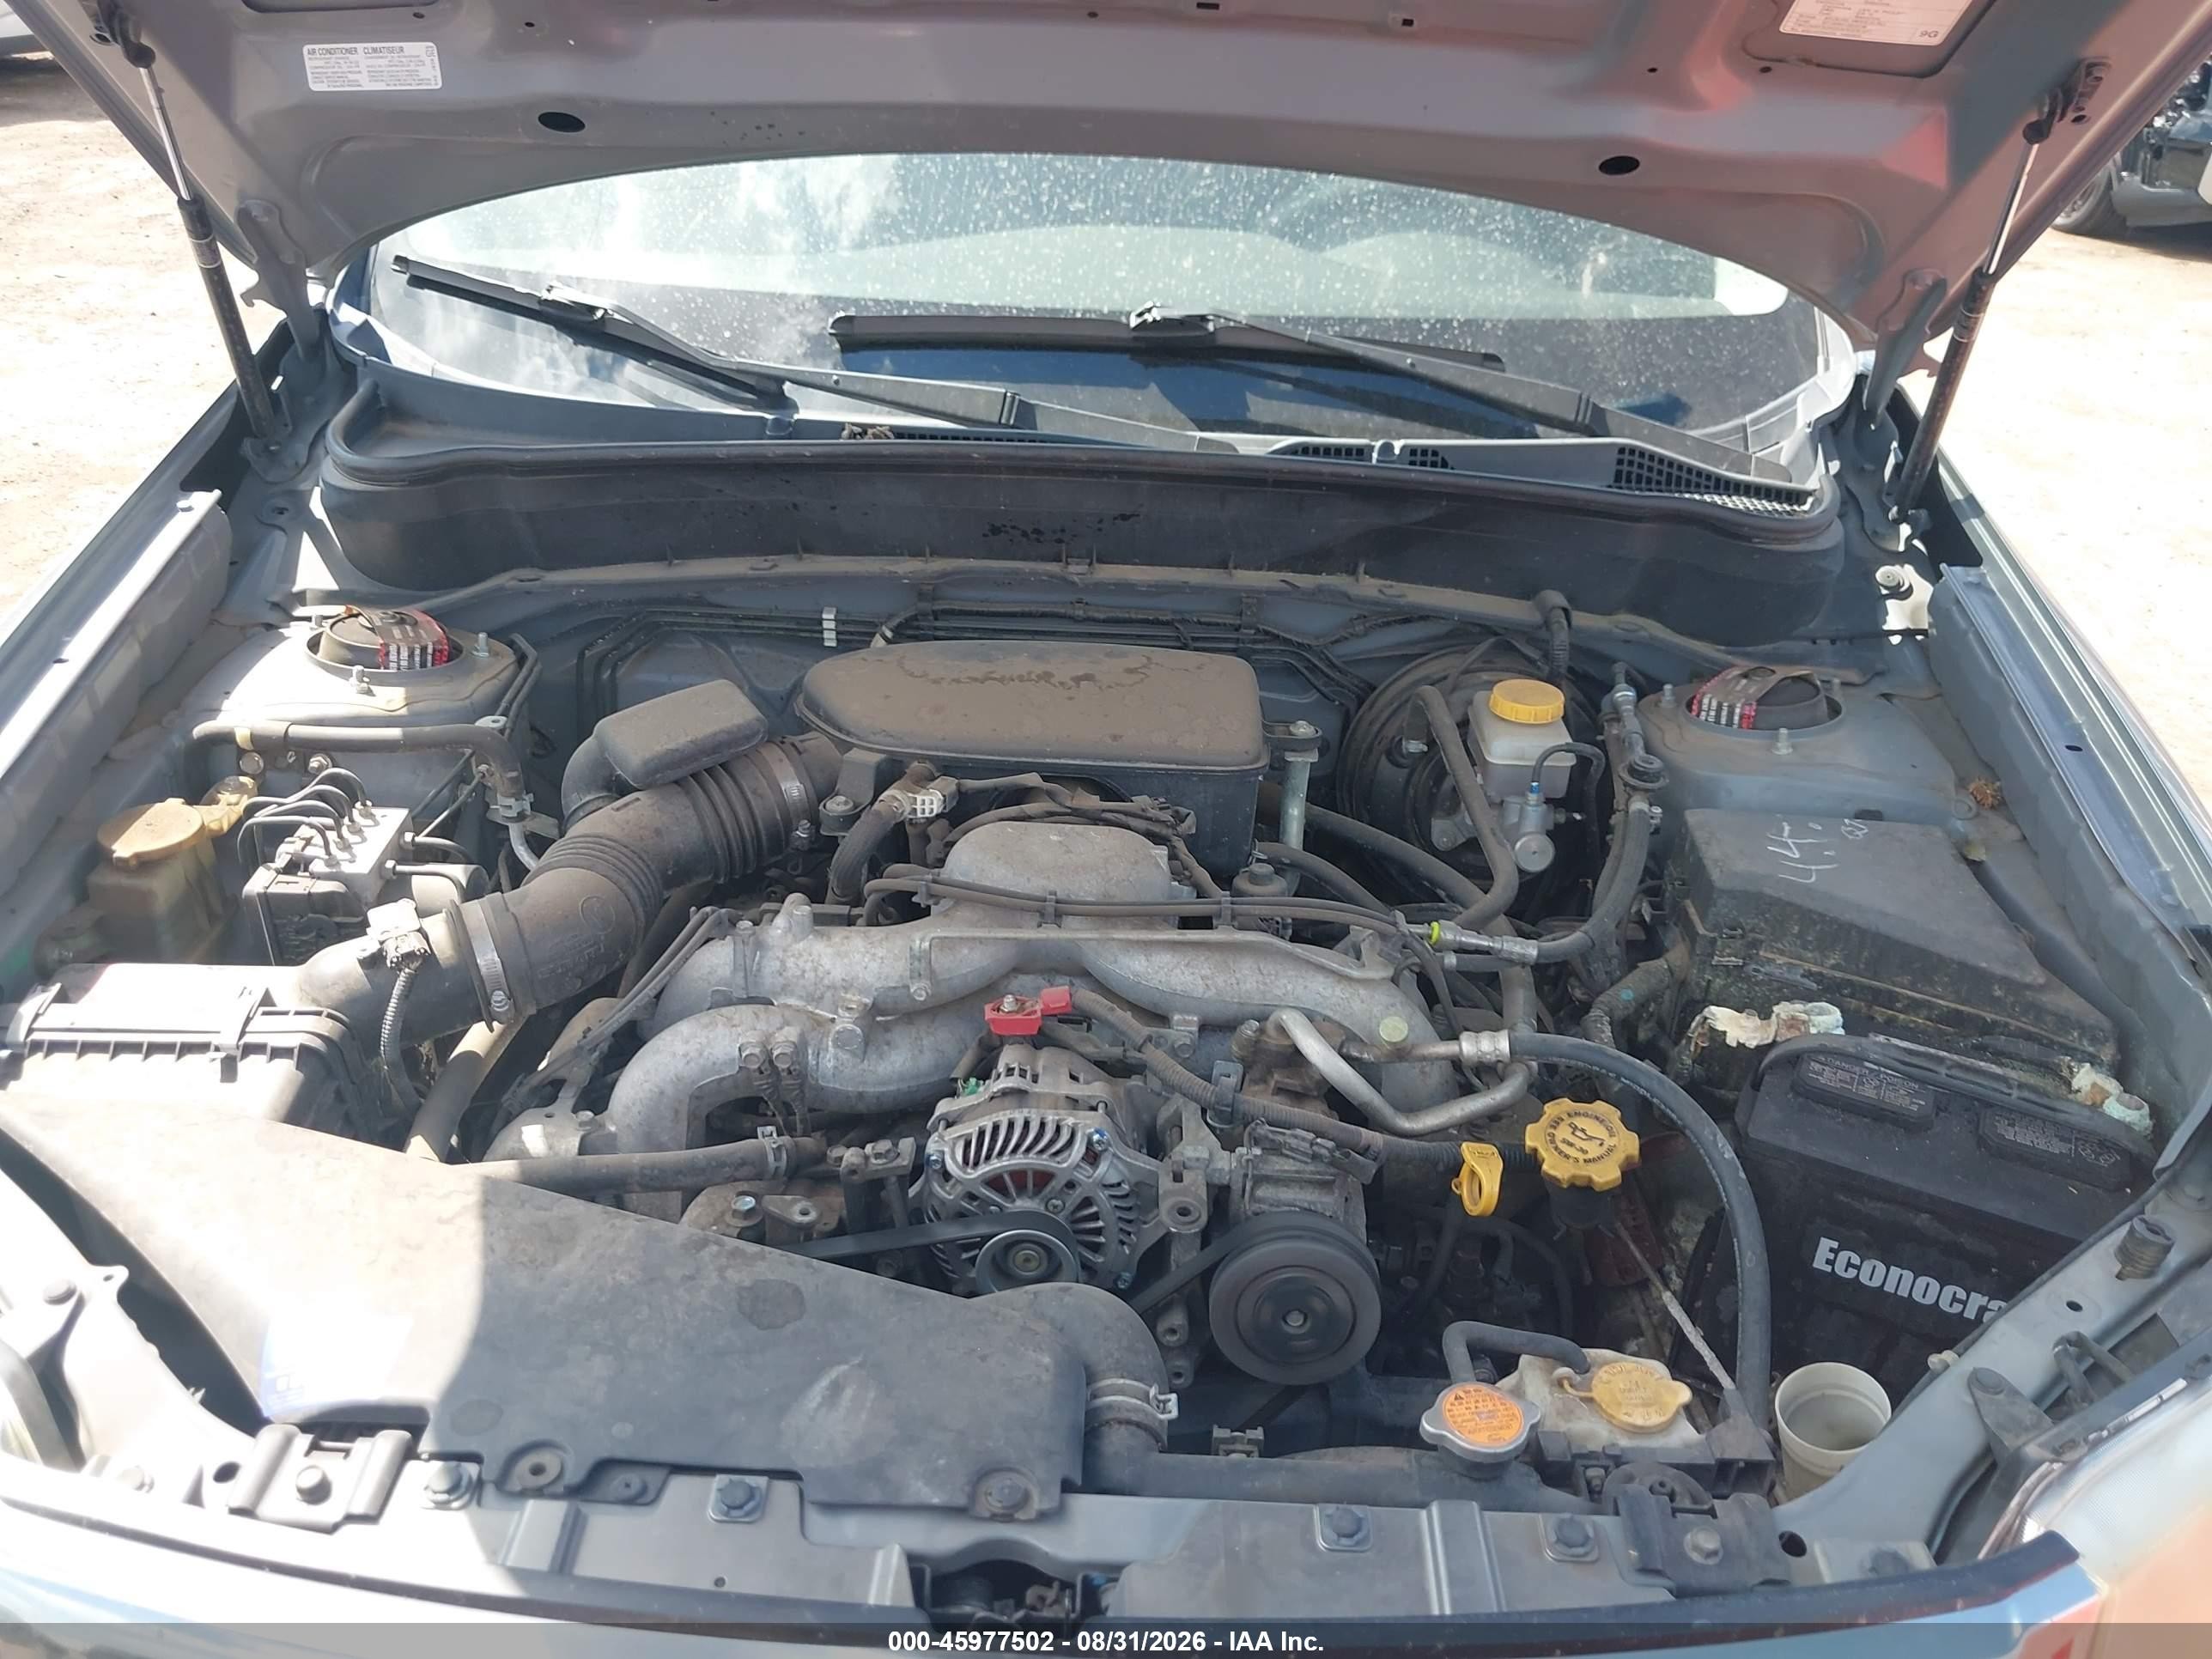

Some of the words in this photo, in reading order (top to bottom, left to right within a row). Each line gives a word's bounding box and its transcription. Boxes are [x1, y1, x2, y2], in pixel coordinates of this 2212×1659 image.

[307, 47, 317, 56] AIR
[318, 46, 358, 56] CONDITIONER
[363, 46, 404, 55] CLIMATISEUR
